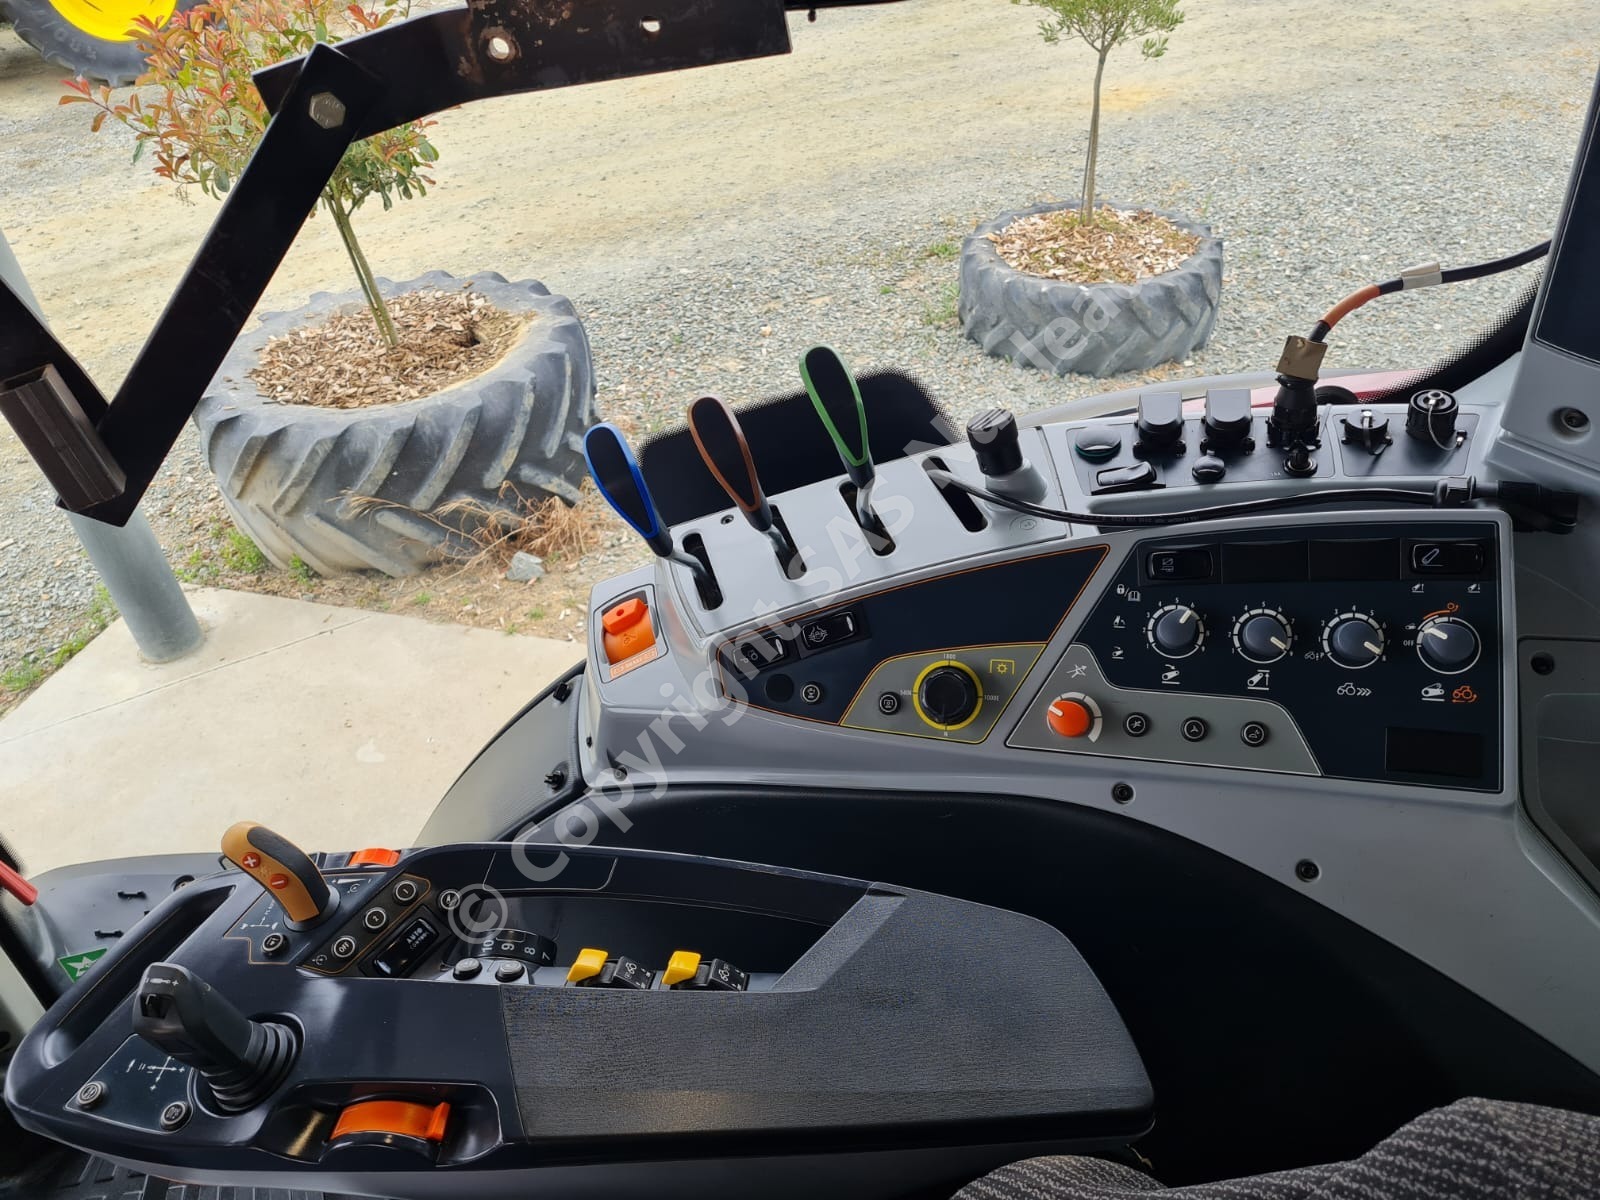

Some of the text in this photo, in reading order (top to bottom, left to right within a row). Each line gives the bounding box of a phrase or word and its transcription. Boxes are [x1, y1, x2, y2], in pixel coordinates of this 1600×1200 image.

[406, 927, 424, 945] AUTO
[480, 939, 494, 953] 10
[524, 946, 536, 955] 8
[541, 951, 551, 961] 7
